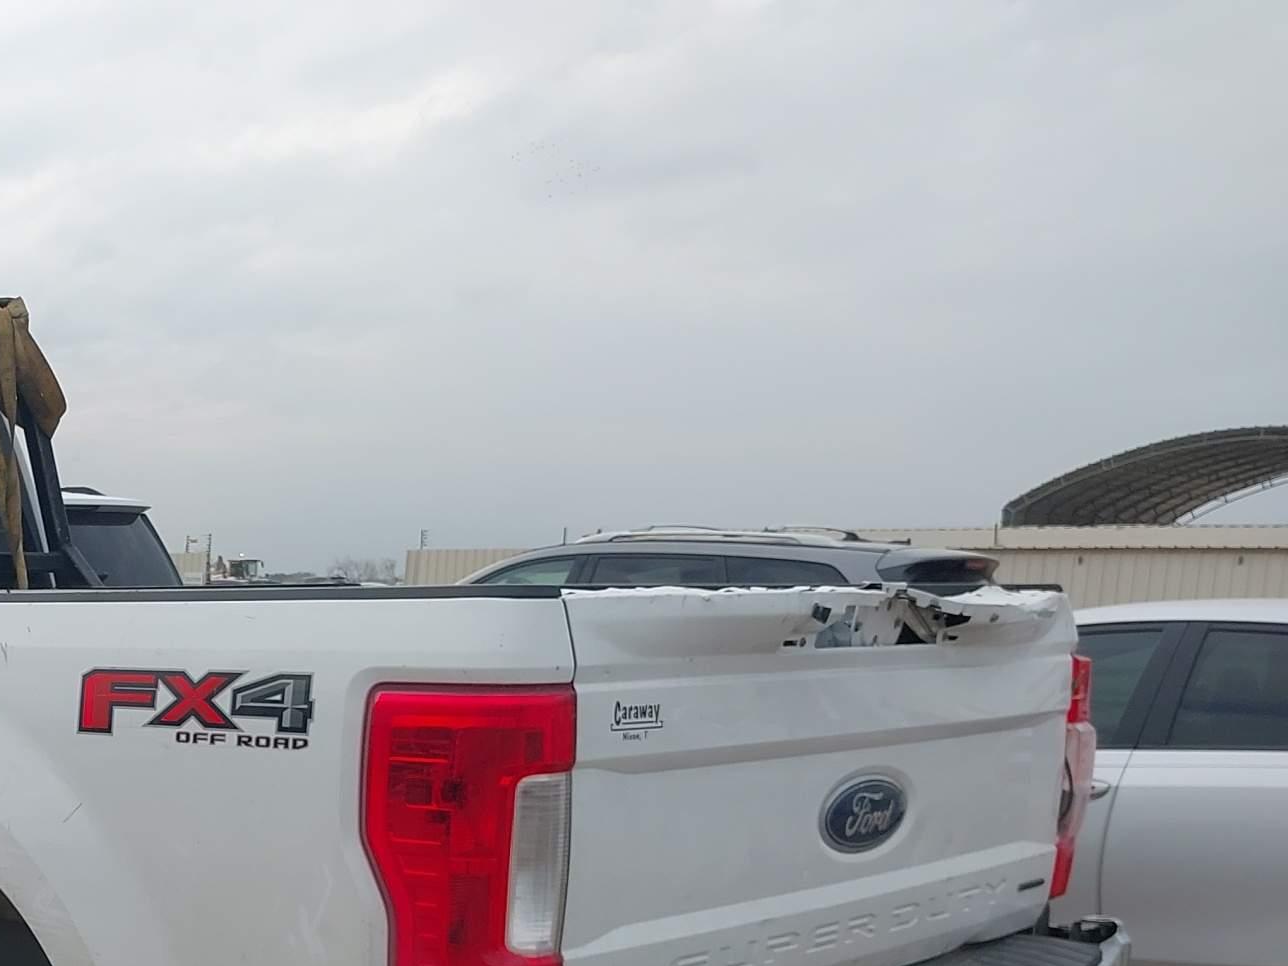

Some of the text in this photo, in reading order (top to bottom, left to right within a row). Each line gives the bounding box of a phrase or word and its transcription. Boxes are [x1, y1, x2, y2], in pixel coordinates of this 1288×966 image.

[77, 668, 313, 733] FX4
[614, 700, 661, 726] Caraway
[175, 731, 309, 750] OFF ROAD
[845, 791, 895, 837] Ford
[889, 878, 1007, 933] DUTY
